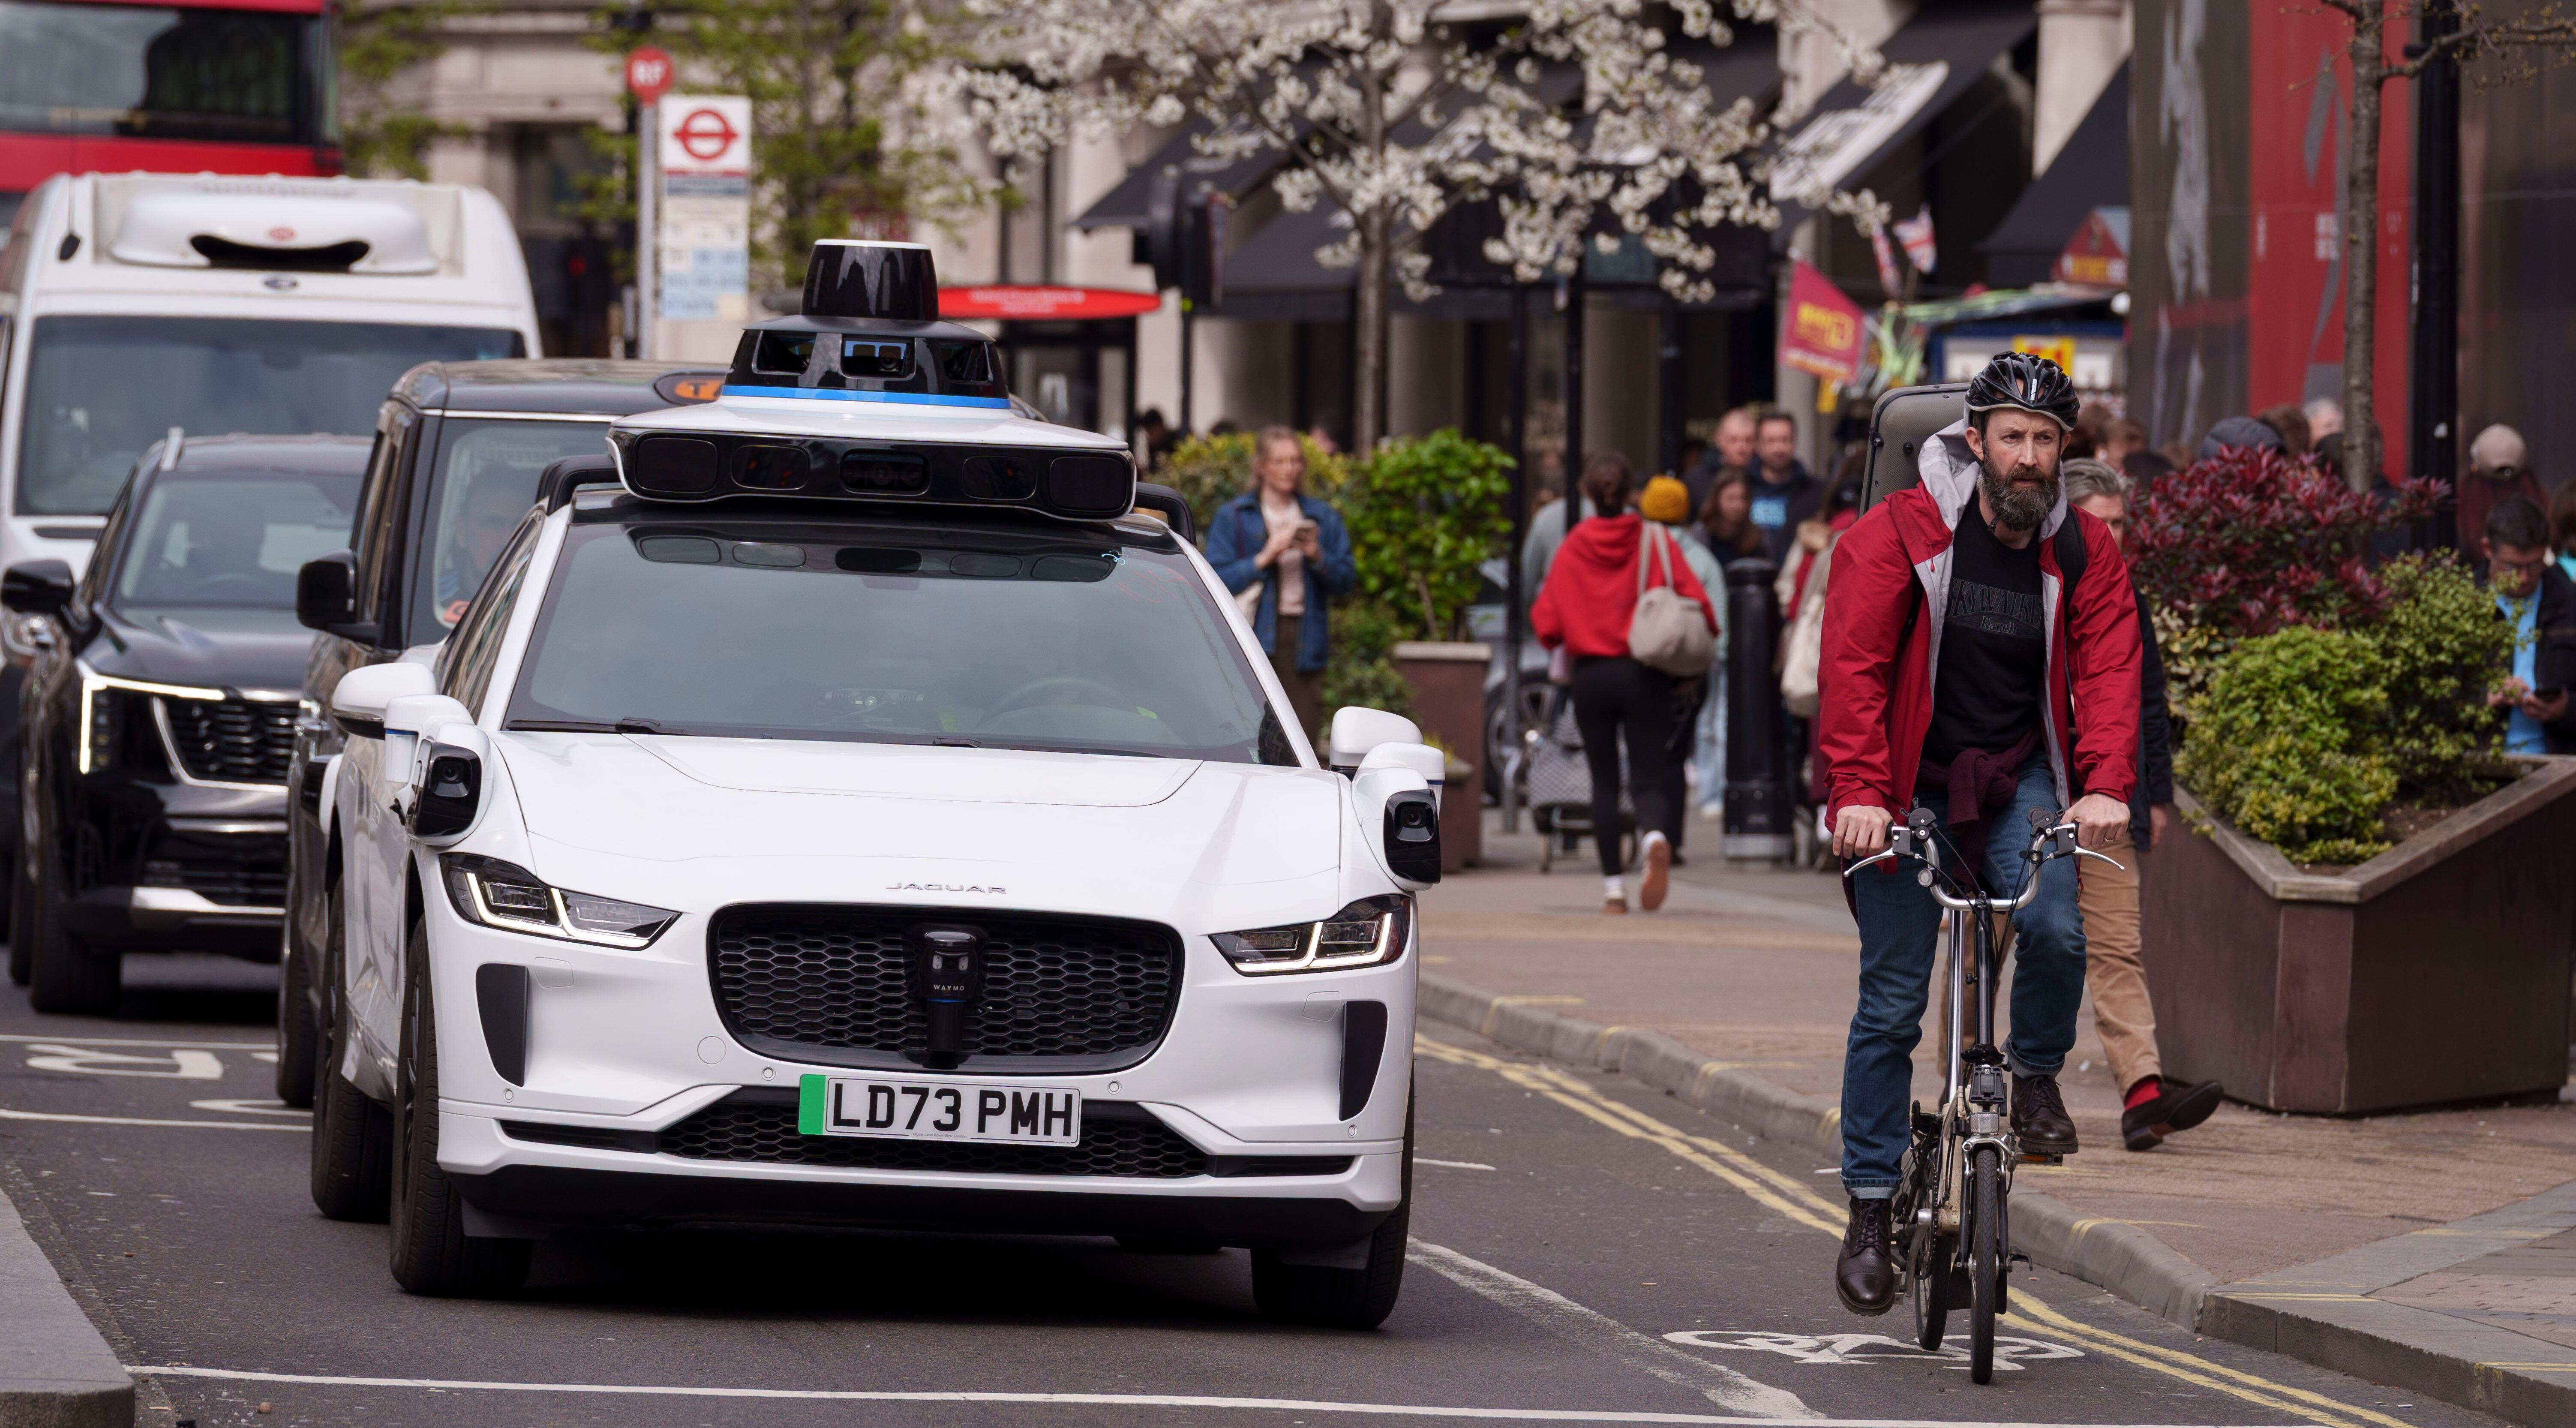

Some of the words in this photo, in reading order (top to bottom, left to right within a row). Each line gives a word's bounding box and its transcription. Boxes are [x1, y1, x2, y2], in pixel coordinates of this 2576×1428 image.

[1946, 577, 2044, 629] SKYWALKE
[1981, 616, 2017, 635] Ranch
[886, 883, 1007, 894] JAGUAR
[832, 1083, 962, 1132] LD73
[978, 1090, 1073, 1137] PMH
